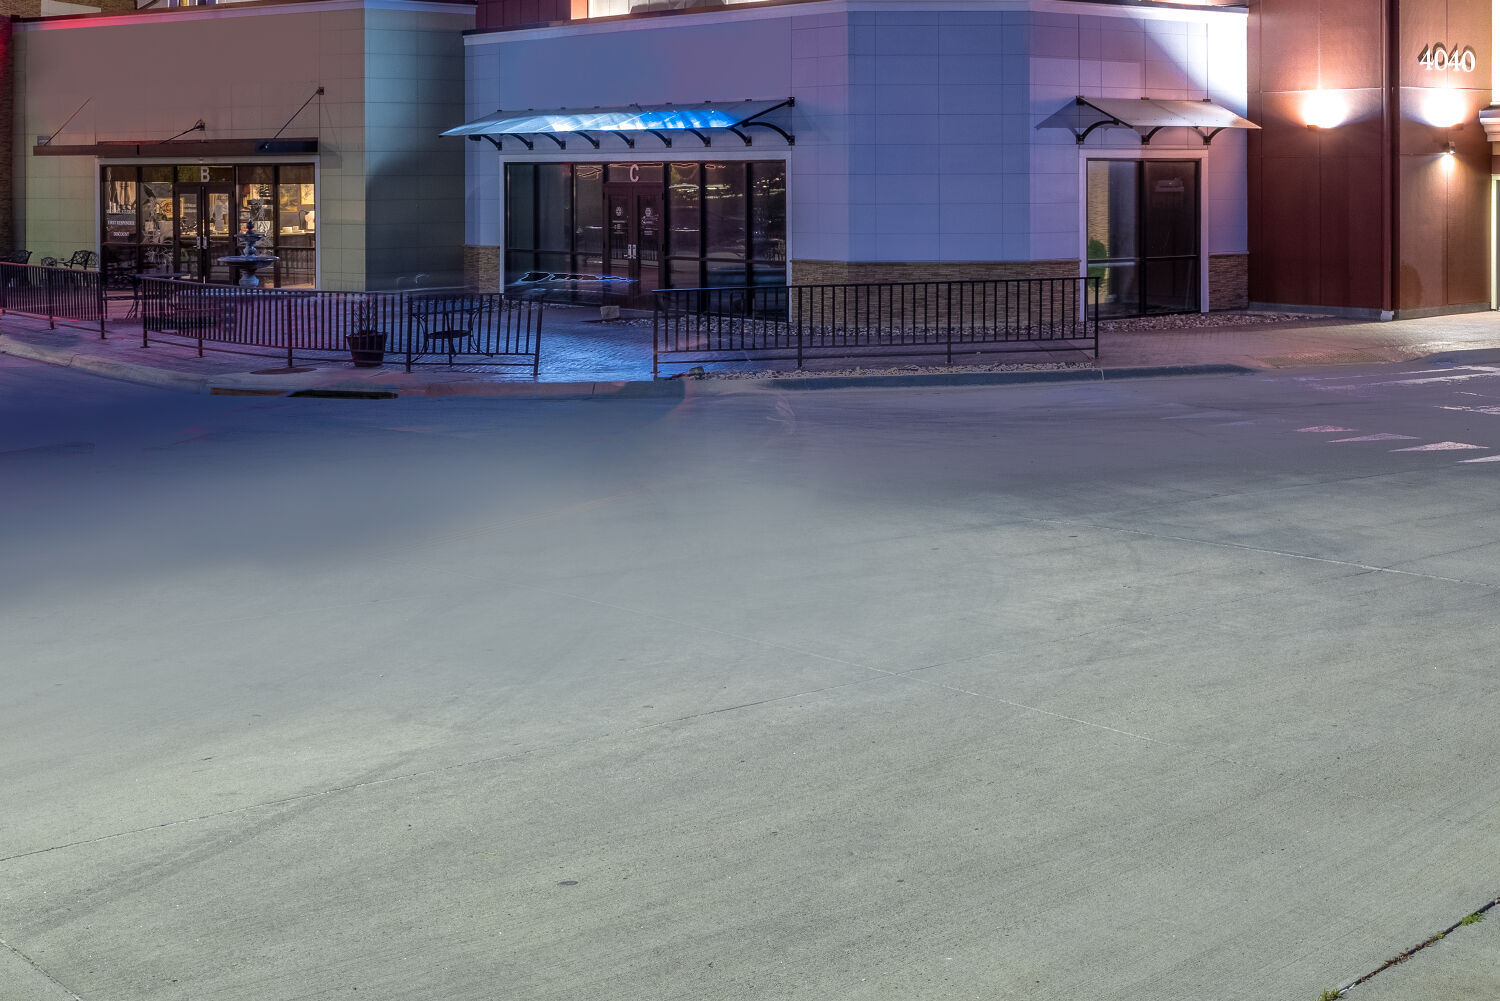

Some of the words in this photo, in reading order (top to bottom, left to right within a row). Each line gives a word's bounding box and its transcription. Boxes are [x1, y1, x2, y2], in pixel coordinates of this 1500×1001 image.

[1419, 48, 1476, 73] 4040
[200, 166, 210, 183] B
[629, 164, 640, 183] C
